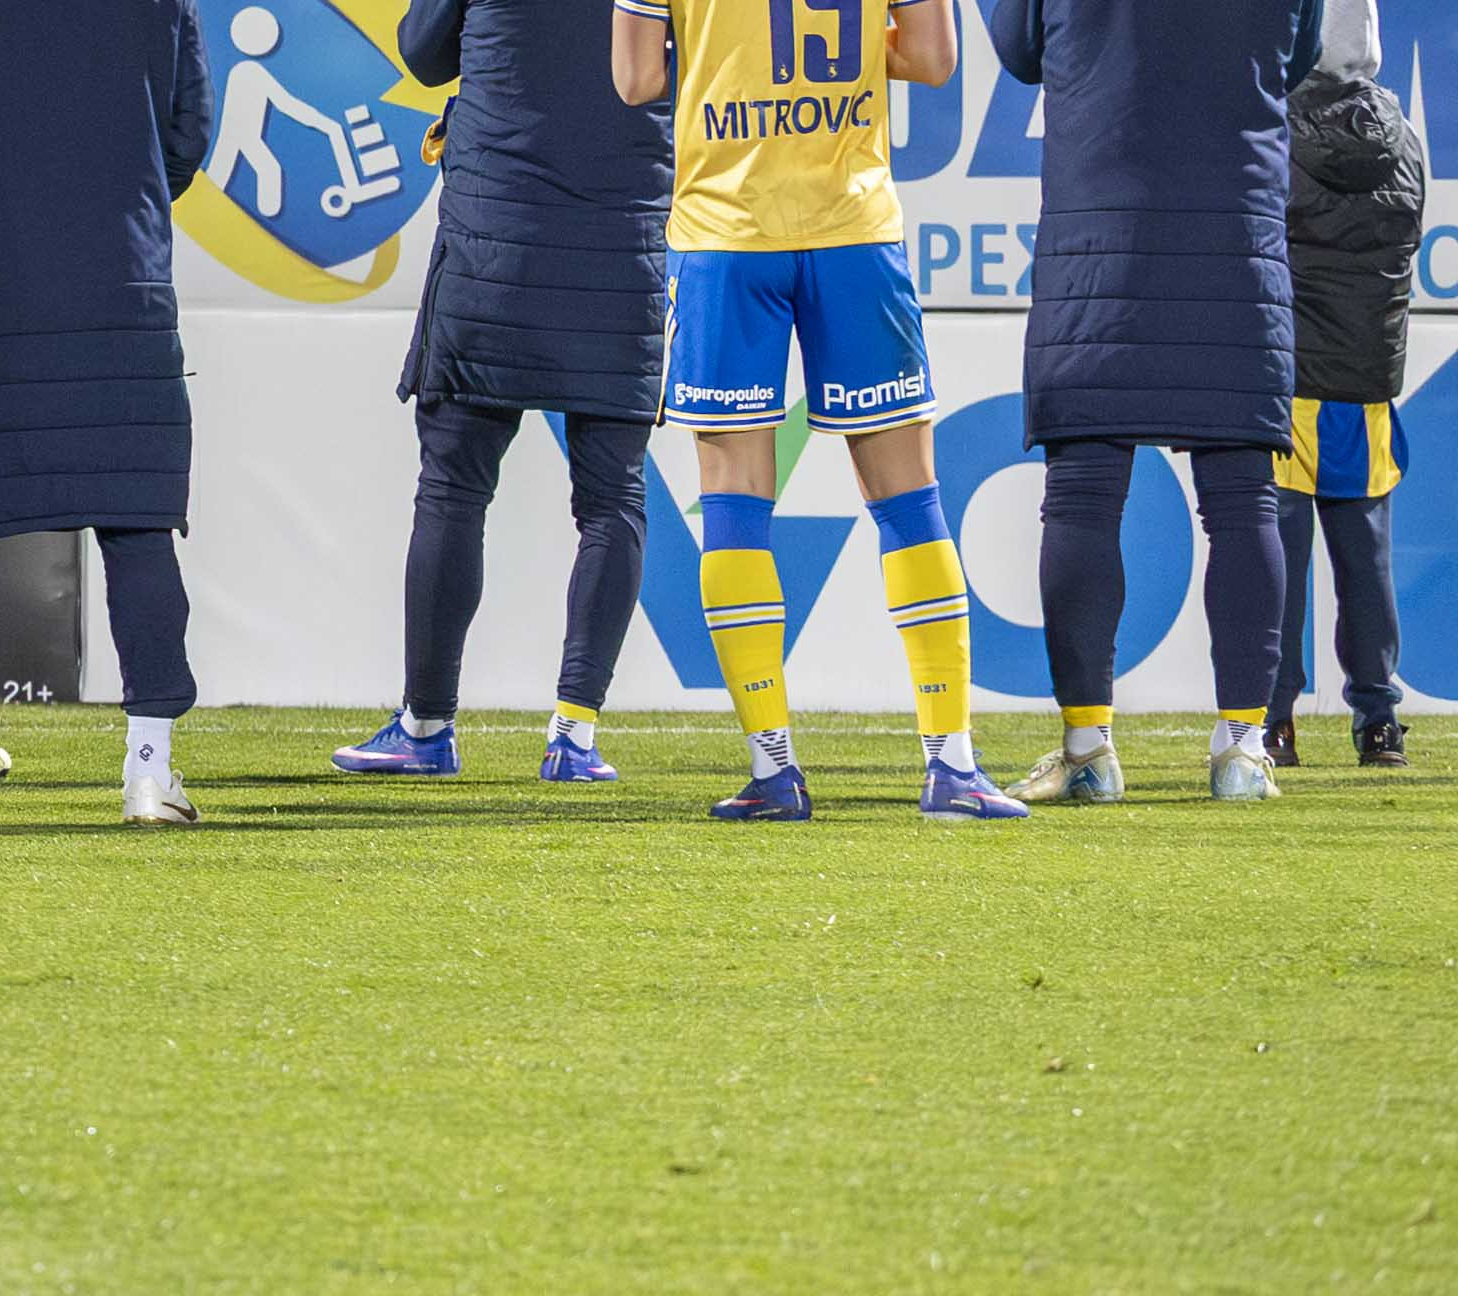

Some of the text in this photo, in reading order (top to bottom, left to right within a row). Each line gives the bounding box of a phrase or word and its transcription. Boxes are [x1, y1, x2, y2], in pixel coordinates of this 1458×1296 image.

[823, 368, 927, 411] Promist
[2, 680, 54, 706] 21+
[743, 679, 775, 693] 1931
[918, 683, 949, 693] 1931
